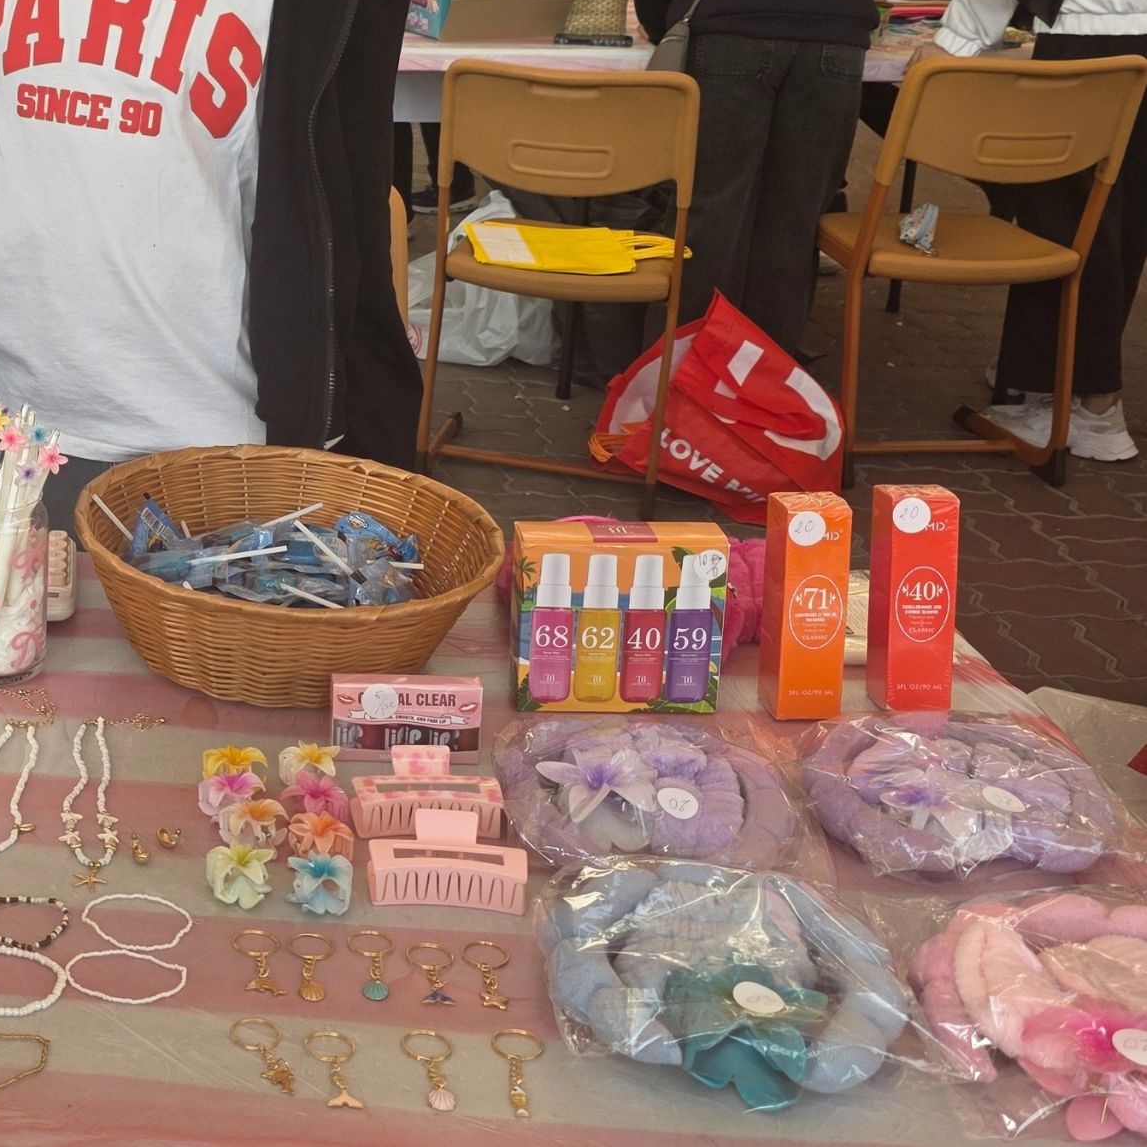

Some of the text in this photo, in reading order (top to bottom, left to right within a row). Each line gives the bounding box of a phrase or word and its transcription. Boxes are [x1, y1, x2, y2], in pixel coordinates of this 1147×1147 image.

[16, 83, 163, 137] SINCE 90
[659, 428, 725, 483] LOVE
[899, 504, 919, 520] 20
[794, 519, 815, 534] 20
[803, 587, 829, 610] 71
[909, 580, 936, 601] 40
[535, 625, 569, 648] 68
[581, 626, 615, 649] 62
[627, 627, 661, 650] 40
[673, 627, 707, 650] 59
[416, 693, 456, 707] CLEAR
